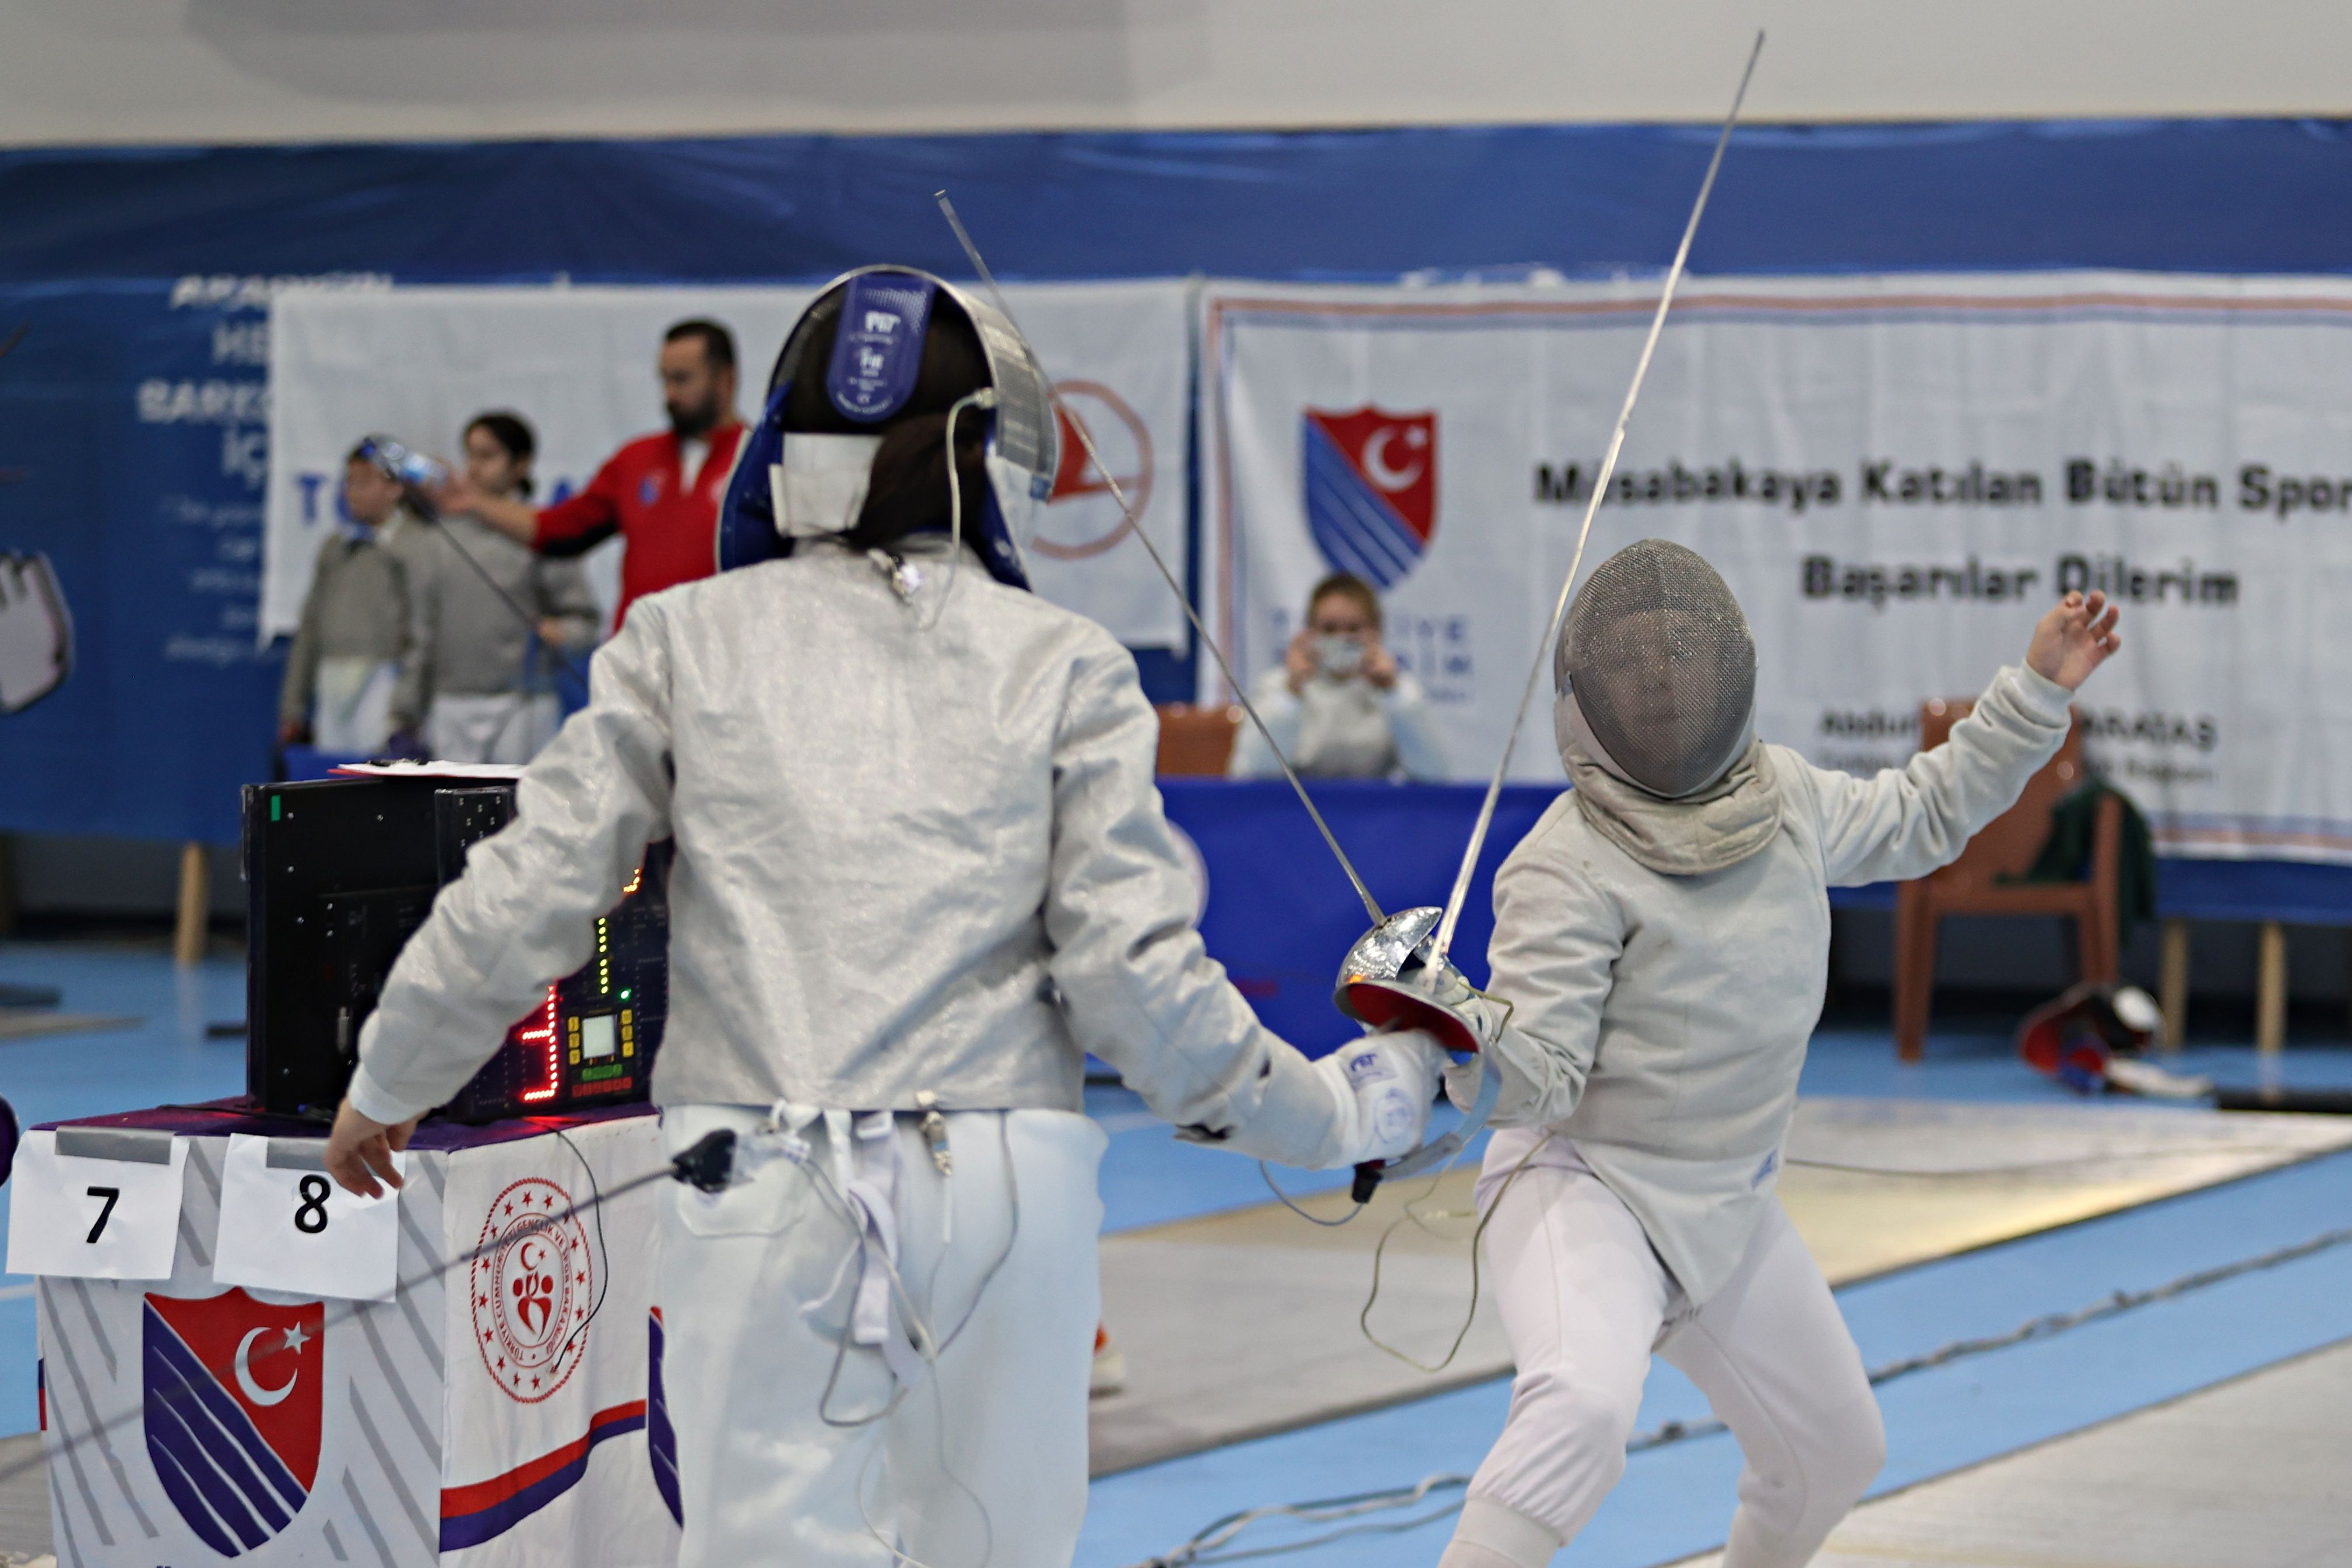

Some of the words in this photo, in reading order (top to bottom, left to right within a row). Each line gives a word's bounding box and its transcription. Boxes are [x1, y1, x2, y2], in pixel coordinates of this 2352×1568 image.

[1861, 456, 2043, 505] Katılan
[2065, 456, 2219, 505] Bütün
[1802, 554, 2037, 614] Başarılar
[2058, 554, 2238, 602] Dilerim
[87, 1186, 120, 1243] 7
[295, 1175, 331, 1233] 8
